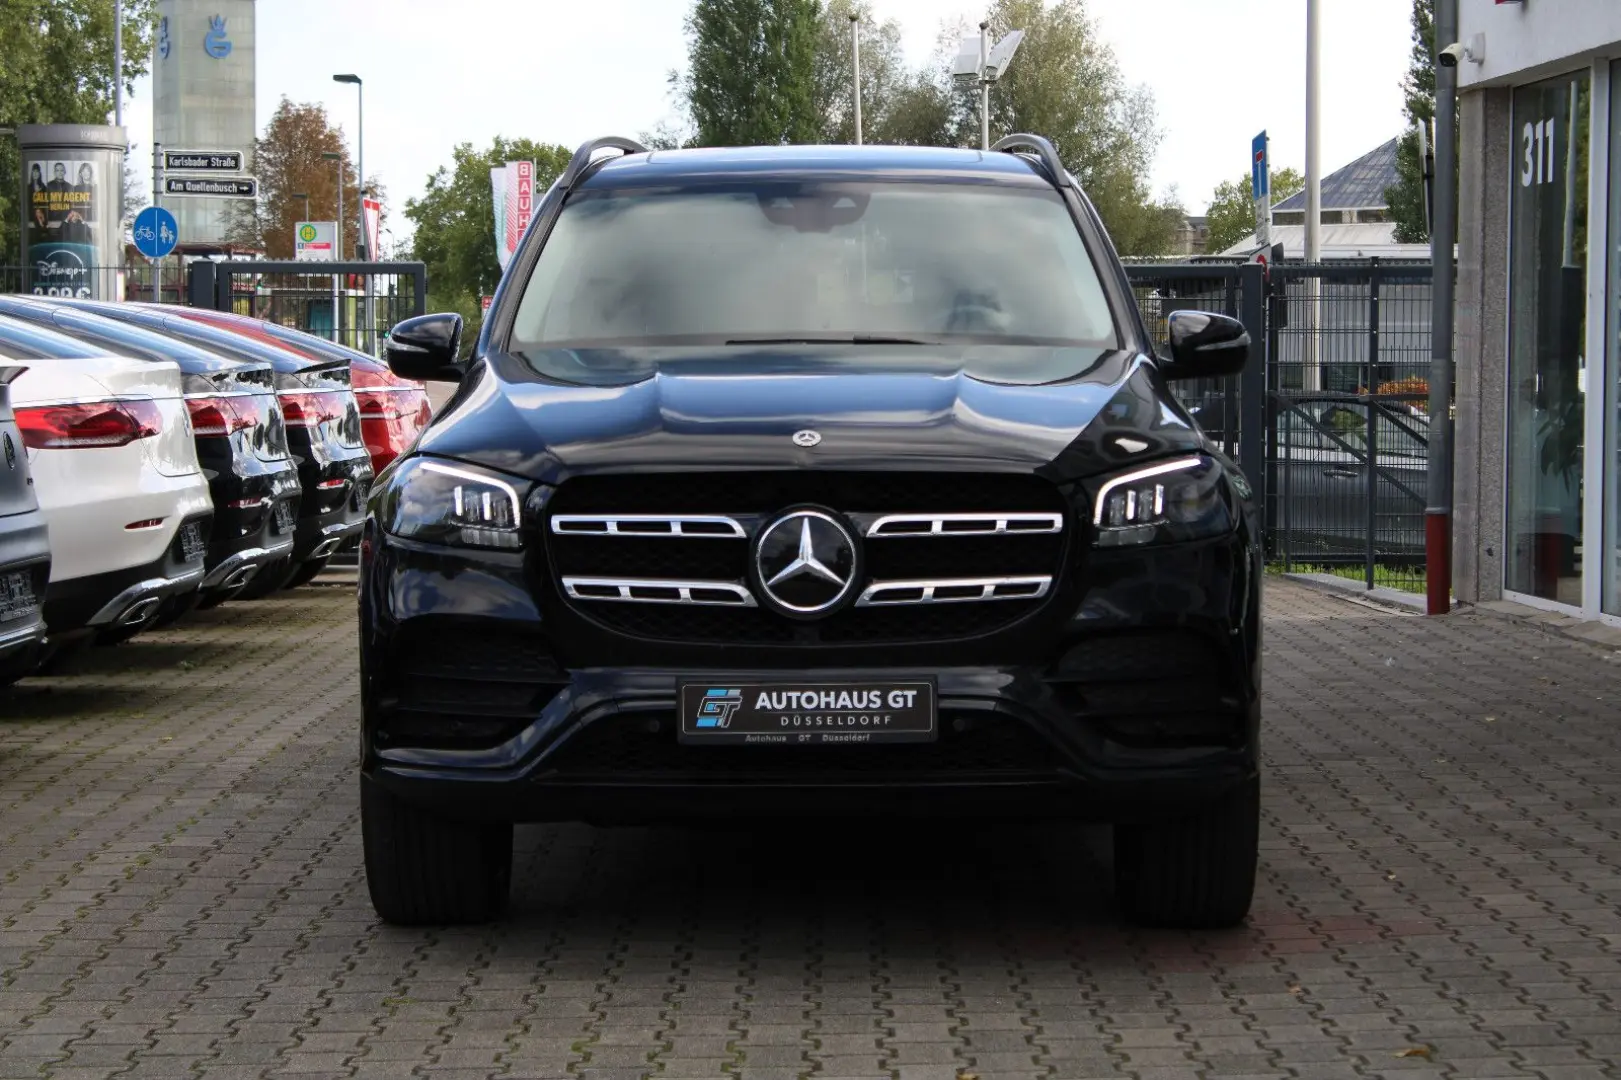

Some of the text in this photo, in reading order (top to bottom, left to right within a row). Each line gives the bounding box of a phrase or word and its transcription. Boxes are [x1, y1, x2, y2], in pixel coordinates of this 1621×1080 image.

[1522, 117, 1554, 187] 311
[169, 156, 236, 167] Karlsbader Straße
[170, 181, 238, 193] Am Quellenbusch
[33, 191, 90, 202] CALL MY AGENT
[518, 162, 531, 240] BAUH
[754, 690, 917, 710] AUTOHAUS GT
[780, 714, 892, 726] DÜSSELDORF
[745, 734, 787, 743] Autohaus
[798, 734, 811, 743] GT
